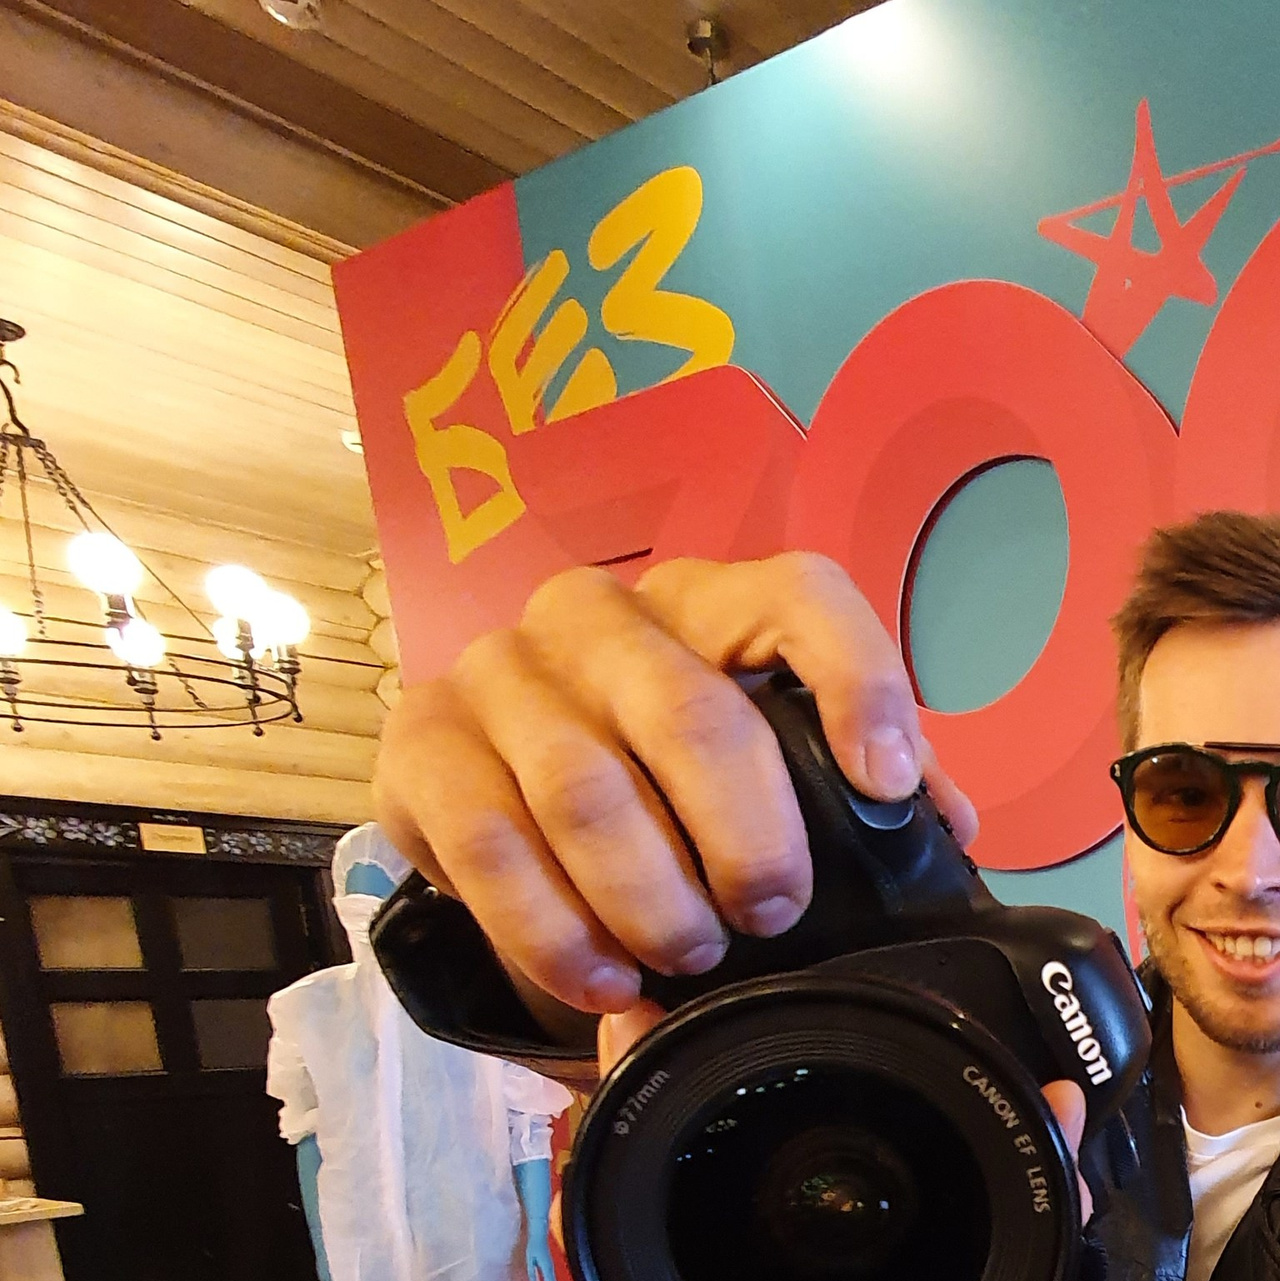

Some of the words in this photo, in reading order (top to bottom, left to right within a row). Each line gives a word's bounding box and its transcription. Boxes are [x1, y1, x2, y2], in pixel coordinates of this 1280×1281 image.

[404, 165, 735, 564] БЕЗ
[1040, 960, 1113, 1086] Canon
[962, 1065, 1020, 1129] CANON
[1013, 1133, 1037, 1156] EF
[1026, 1166, 1051, 1213] LENS
